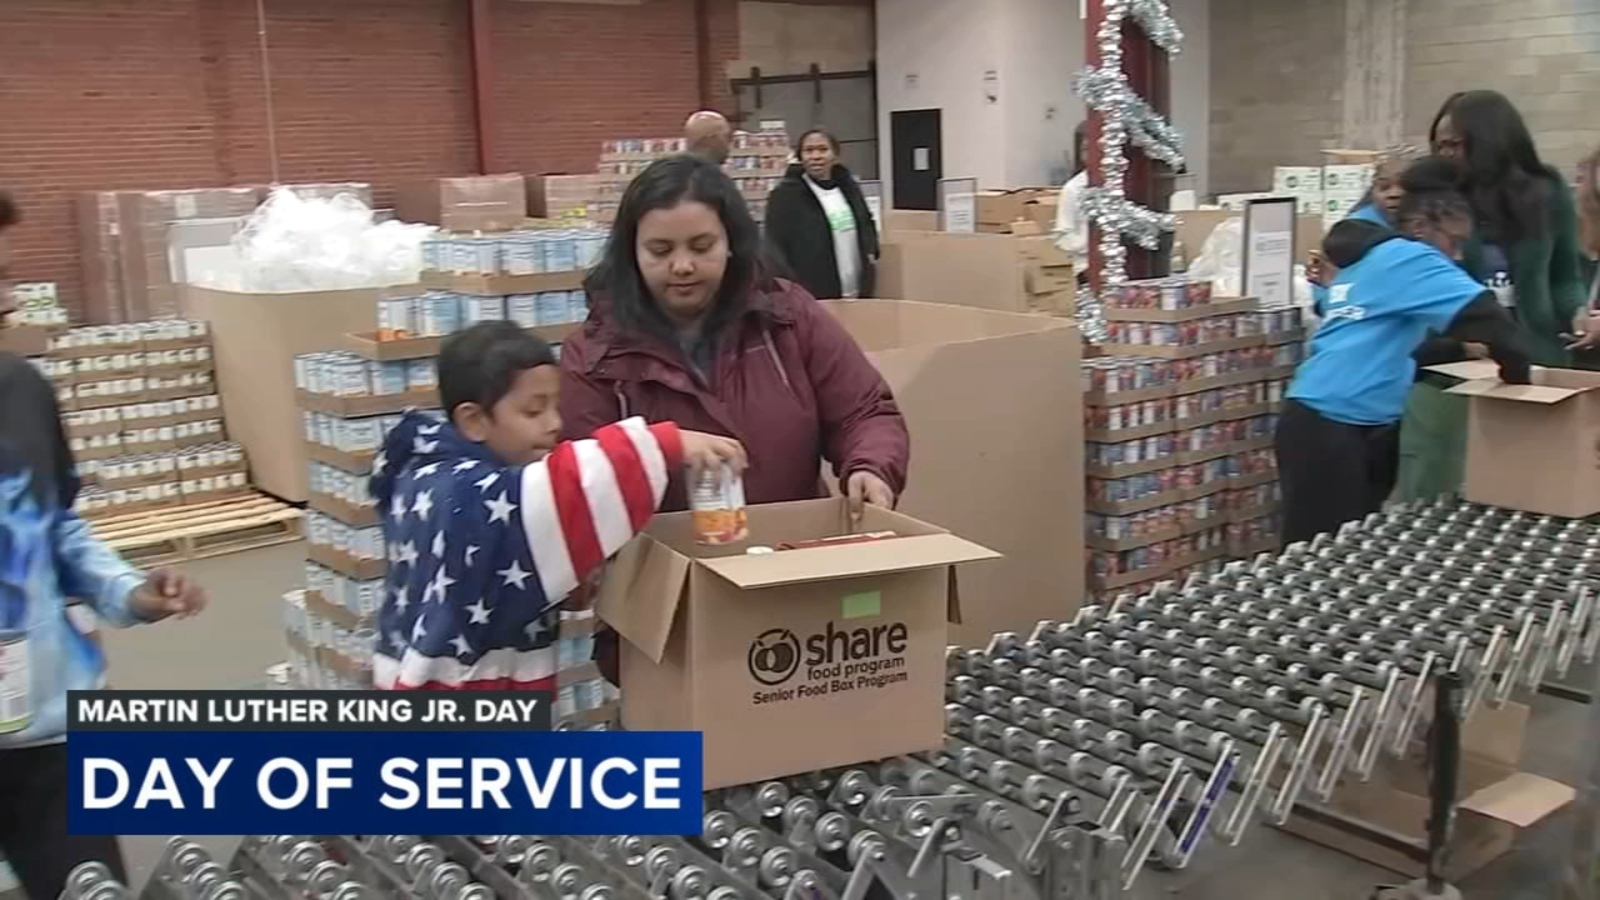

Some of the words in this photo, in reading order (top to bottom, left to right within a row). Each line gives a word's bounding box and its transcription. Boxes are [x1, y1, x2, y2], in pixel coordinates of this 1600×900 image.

[806, 620, 908, 666] share
[807, 662, 841, 681] food
[845, 657, 905, 678] program
[753, 690, 795, 705] Senior
[798, 681, 828, 698] Food
[831, 677, 854, 693] Box
[858, 672, 908, 690] Program
